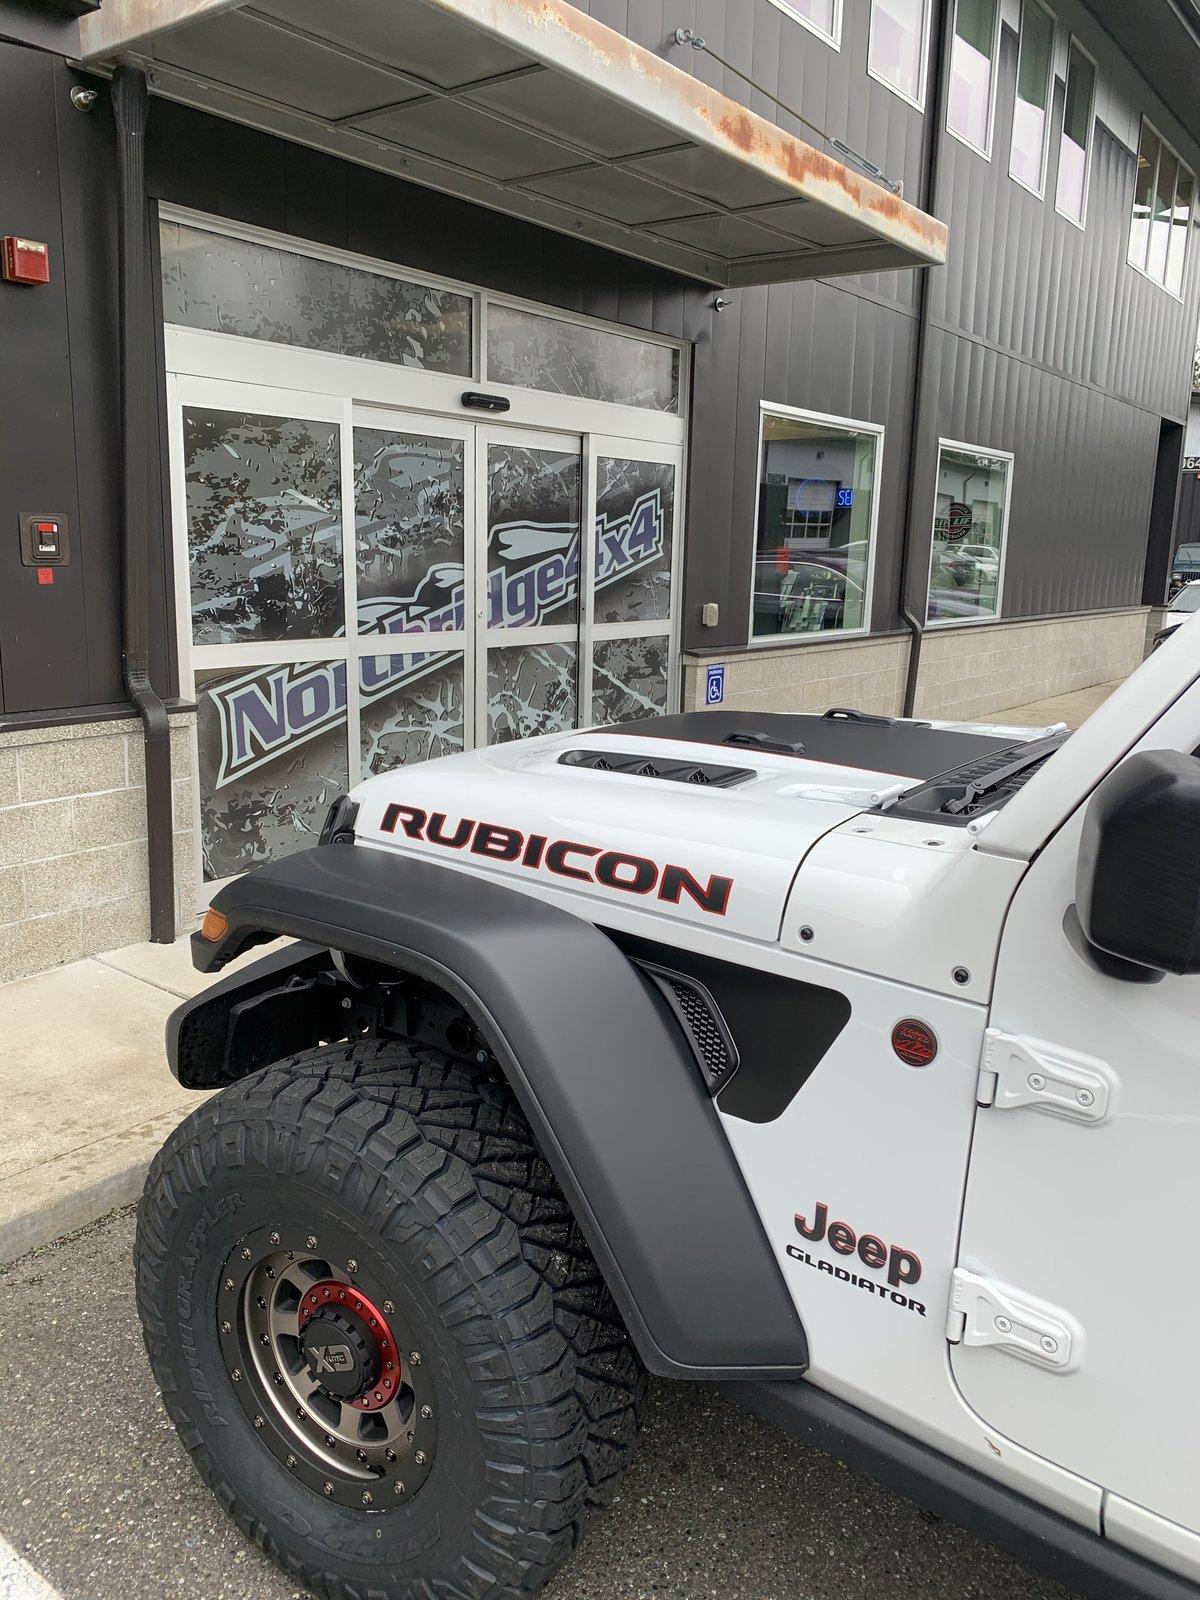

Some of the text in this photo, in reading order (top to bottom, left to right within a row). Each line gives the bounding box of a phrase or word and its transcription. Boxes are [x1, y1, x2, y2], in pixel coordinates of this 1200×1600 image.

[379, 802, 734, 916] RUBICON
[785, 1244, 927, 1318] GLADIATOR
[794, 1201, 922, 1288] Jeep
[308, 1344, 355, 1373] XD
